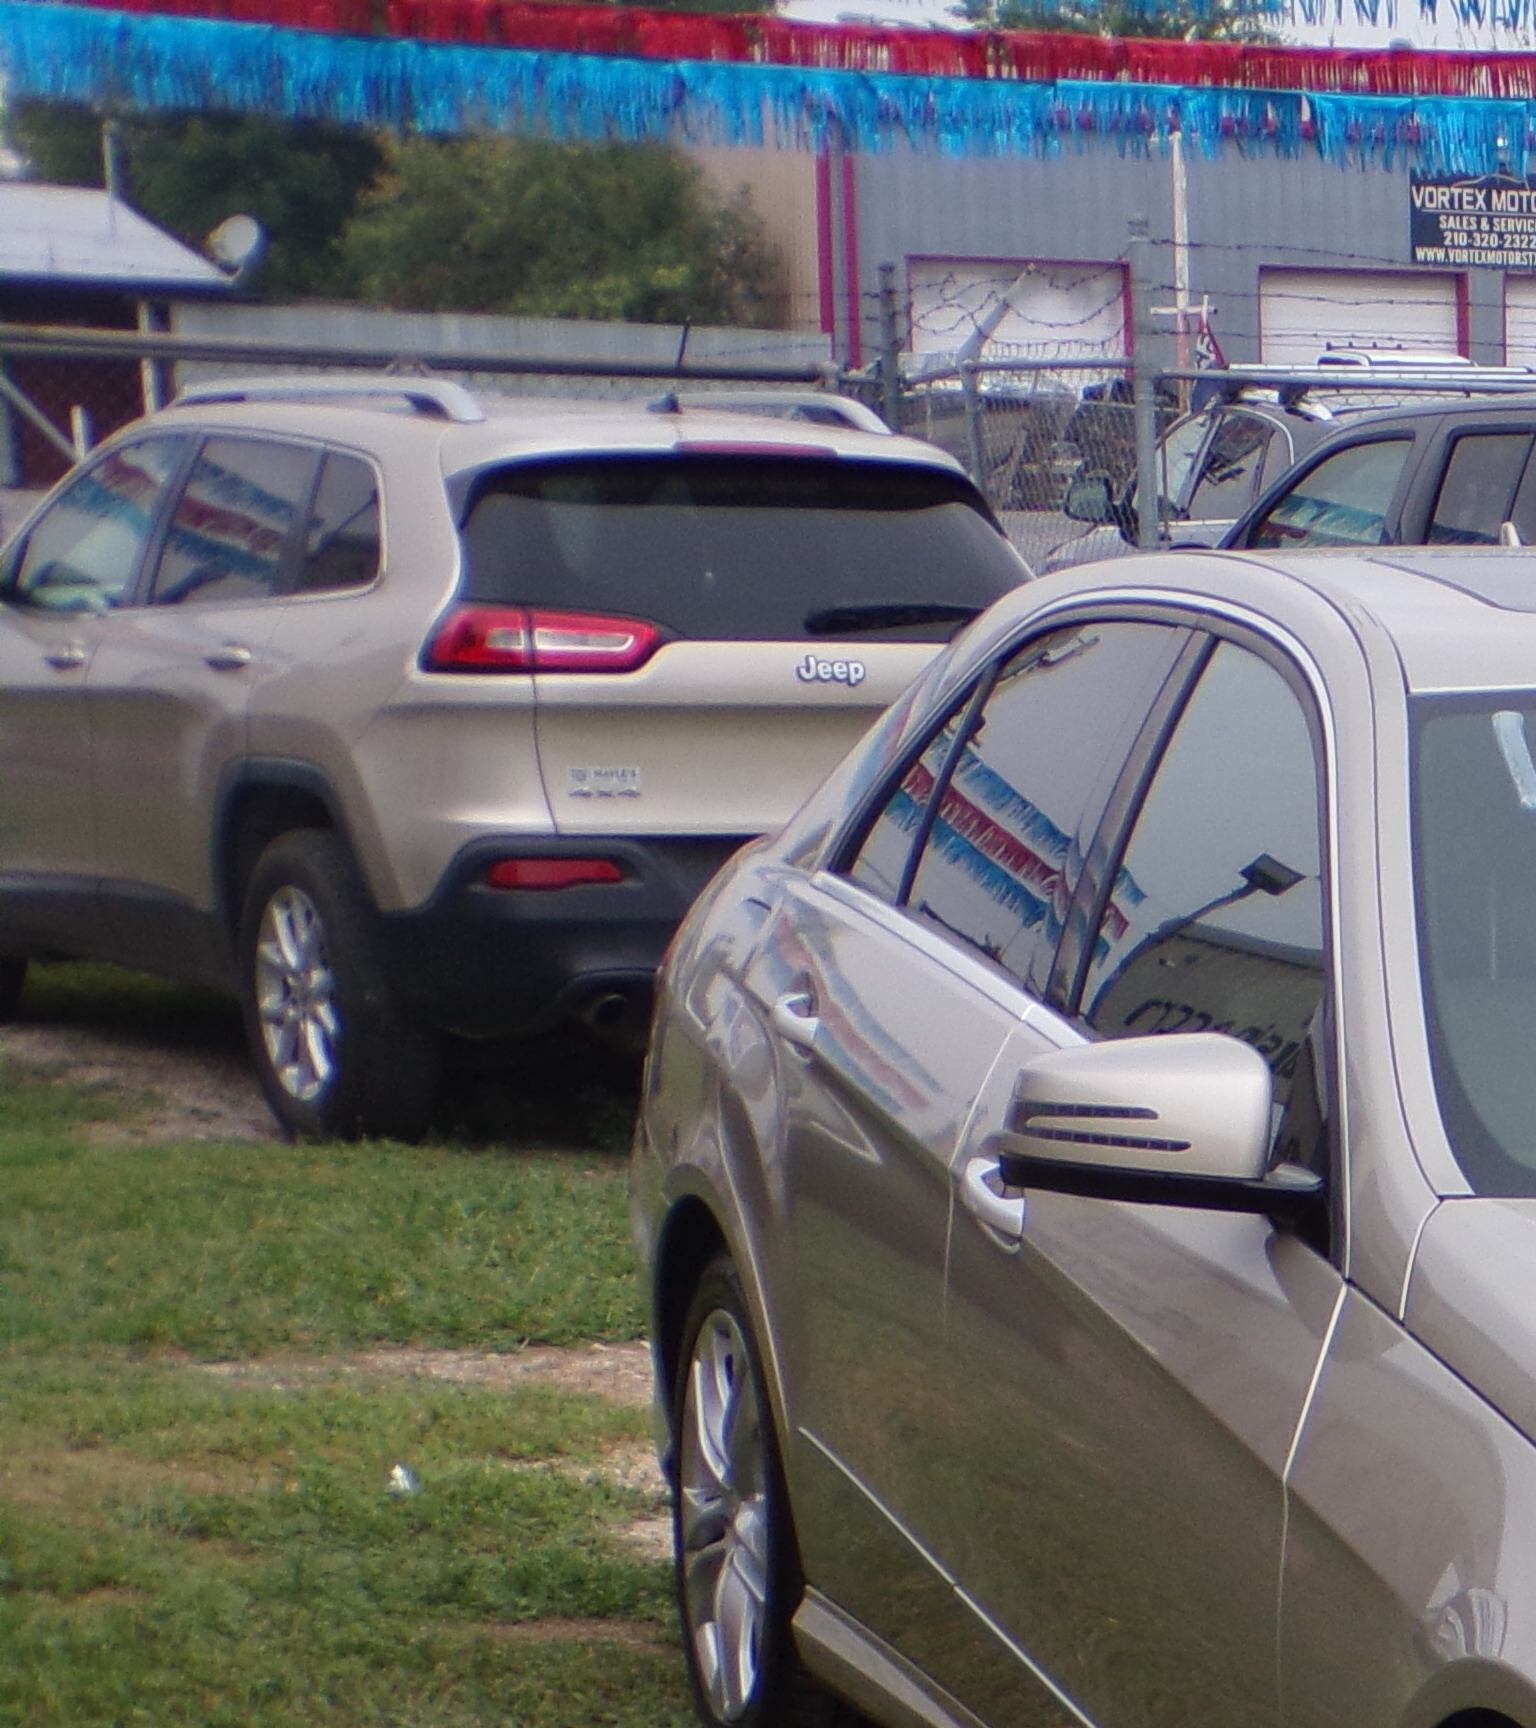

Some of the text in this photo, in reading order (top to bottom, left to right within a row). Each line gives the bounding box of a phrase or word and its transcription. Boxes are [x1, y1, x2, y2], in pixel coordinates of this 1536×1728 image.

[1411, 185, 1487, 211] VORTEX
[1439, 215, 1477, 230] SALES
[1480, 217, 1490, 231] &
[796, 655, 867, 687] Jeep
